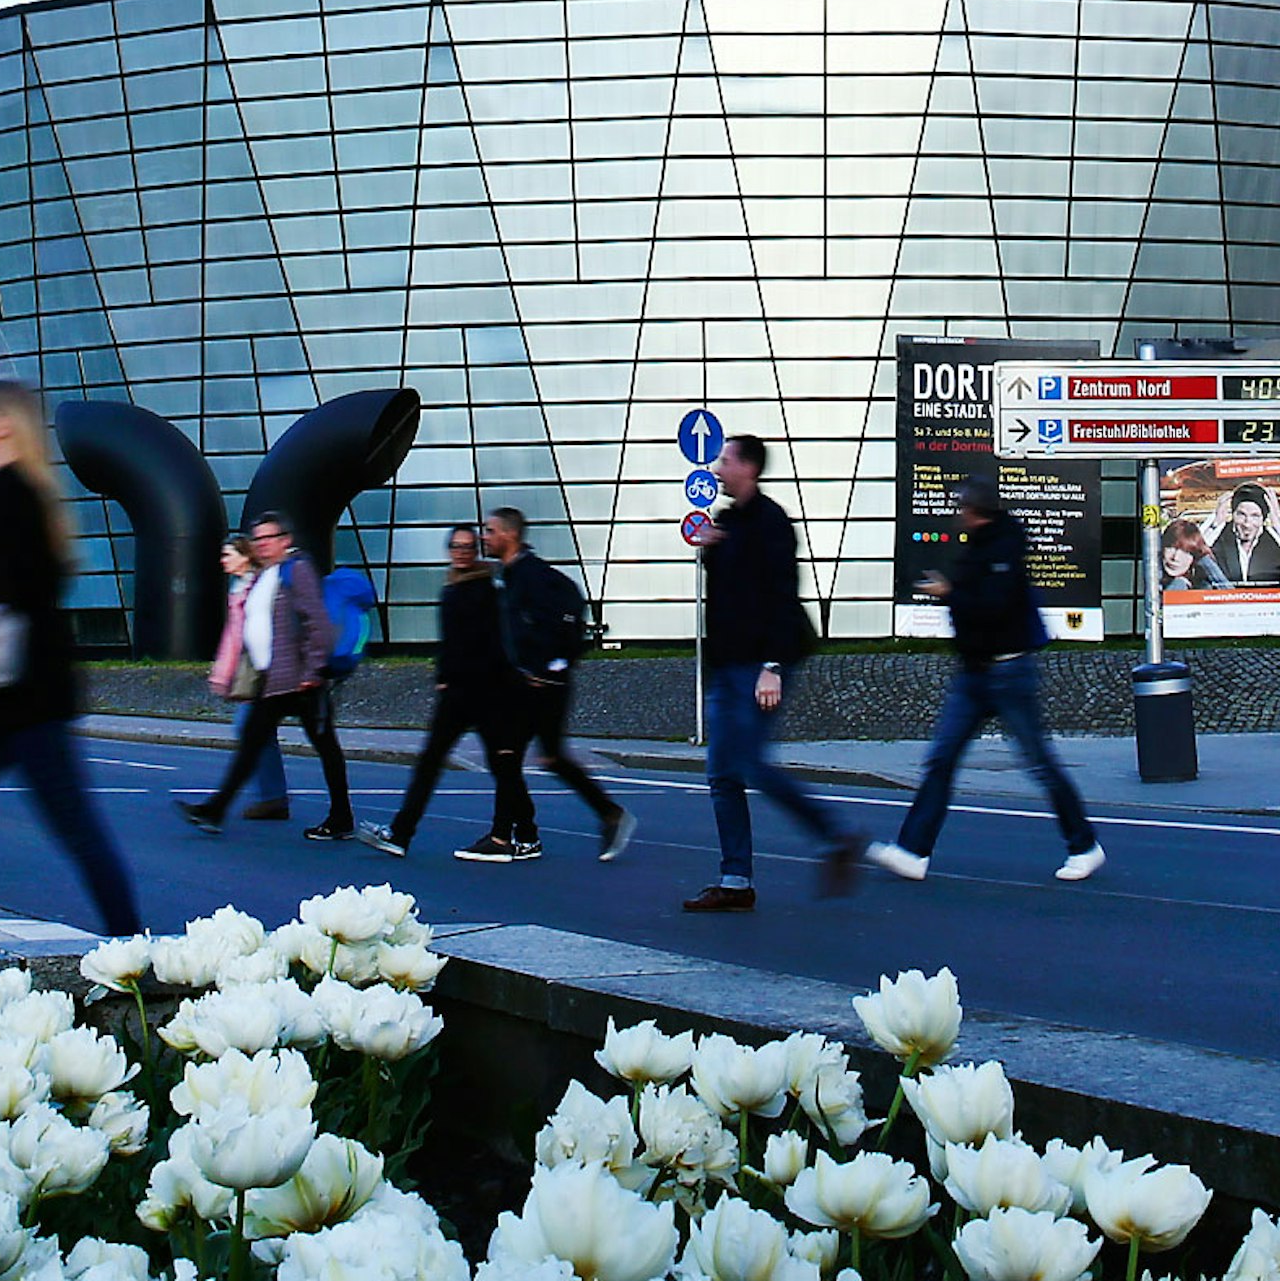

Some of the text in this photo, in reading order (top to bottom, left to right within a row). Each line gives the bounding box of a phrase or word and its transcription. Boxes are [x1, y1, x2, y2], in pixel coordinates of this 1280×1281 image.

[1041, 378, 1056, 398] P
[1073, 379, 1132, 397] Zentrum
[1136, 379, 1170, 397] Nord
[913, 401, 987, 419] EINE STADT.
[935, 427, 952, 438] und
[974, 428, 991, 439] Mai
[1073, 423, 1191, 438] Freistuhl/Bibliothek
[915, 440, 926, 450] in
[928, 440, 947, 451] der
